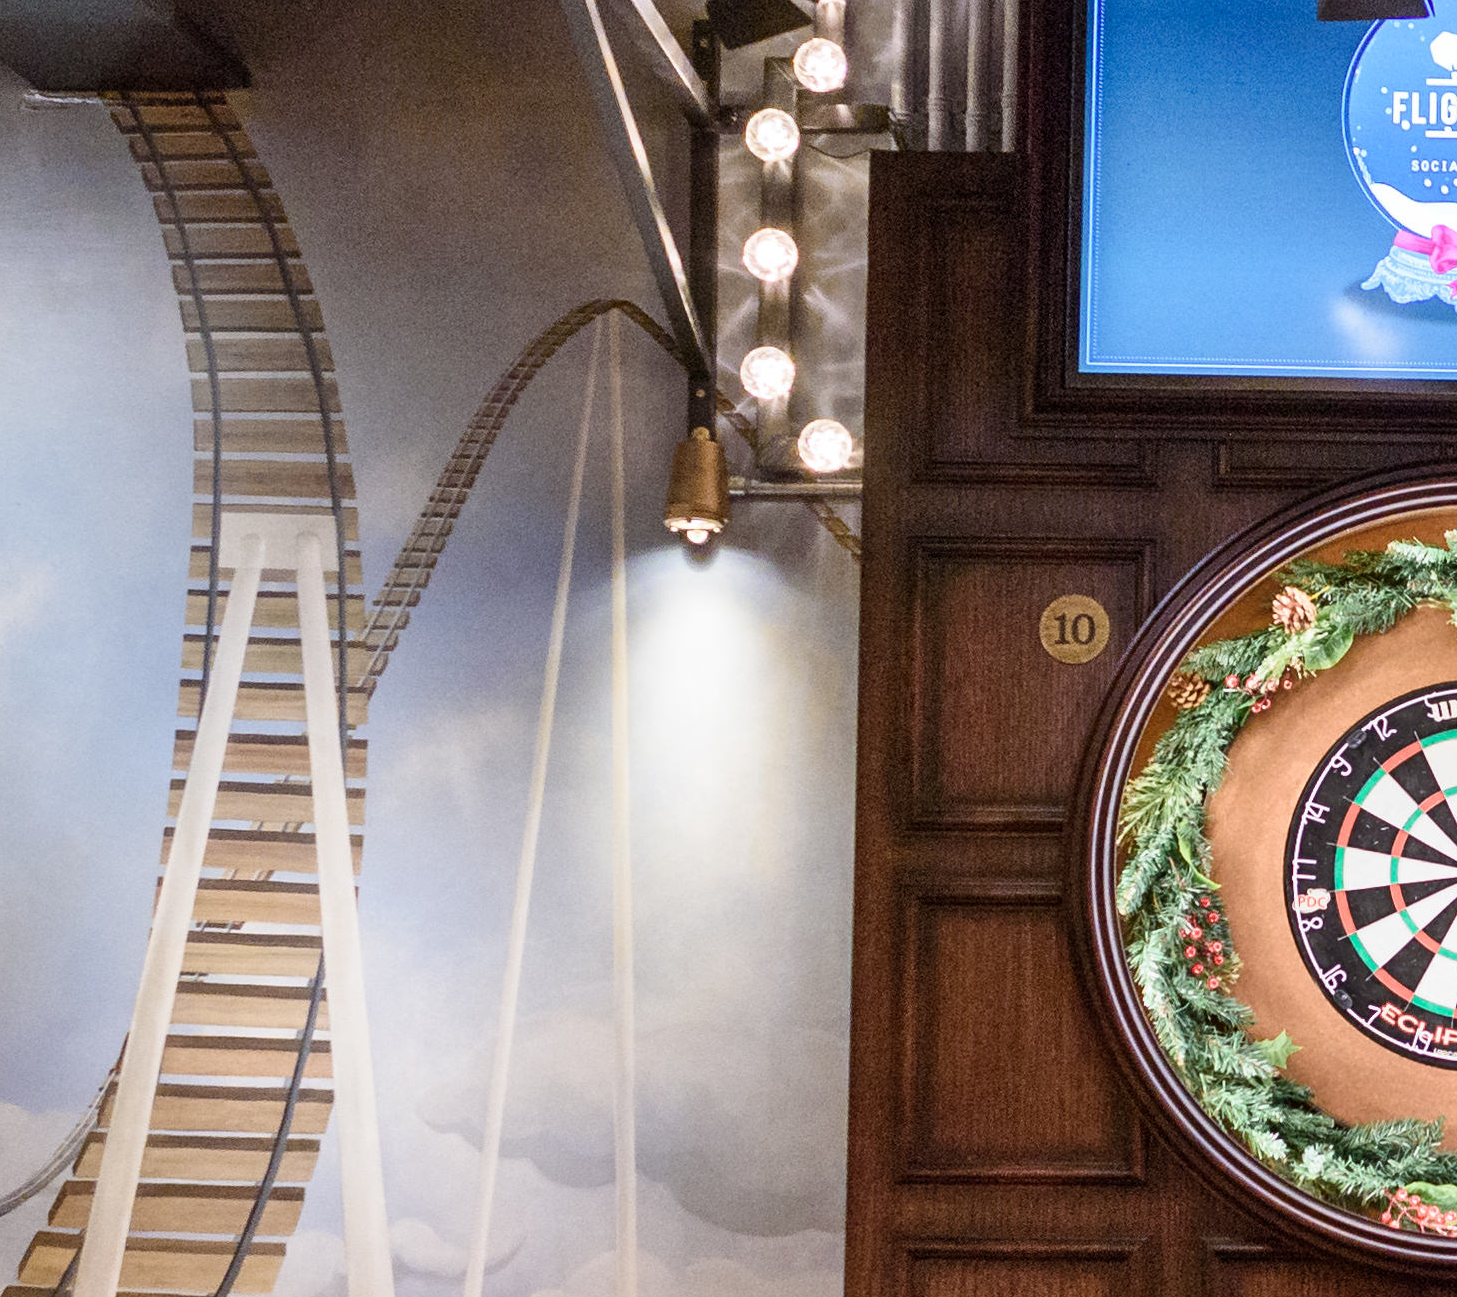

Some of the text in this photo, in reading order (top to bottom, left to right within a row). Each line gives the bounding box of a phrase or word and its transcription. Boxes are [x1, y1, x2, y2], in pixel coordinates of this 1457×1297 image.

[1054, 612, 1096, 645] 10
[1330, 755, 1353, 777] 9
[1302, 801, 1331, 825] 14
[1298, 894, 1327, 910] PDC
[1300, 916, 1324, 933] 8
[1368, 1004, 1382, 1025] 7
